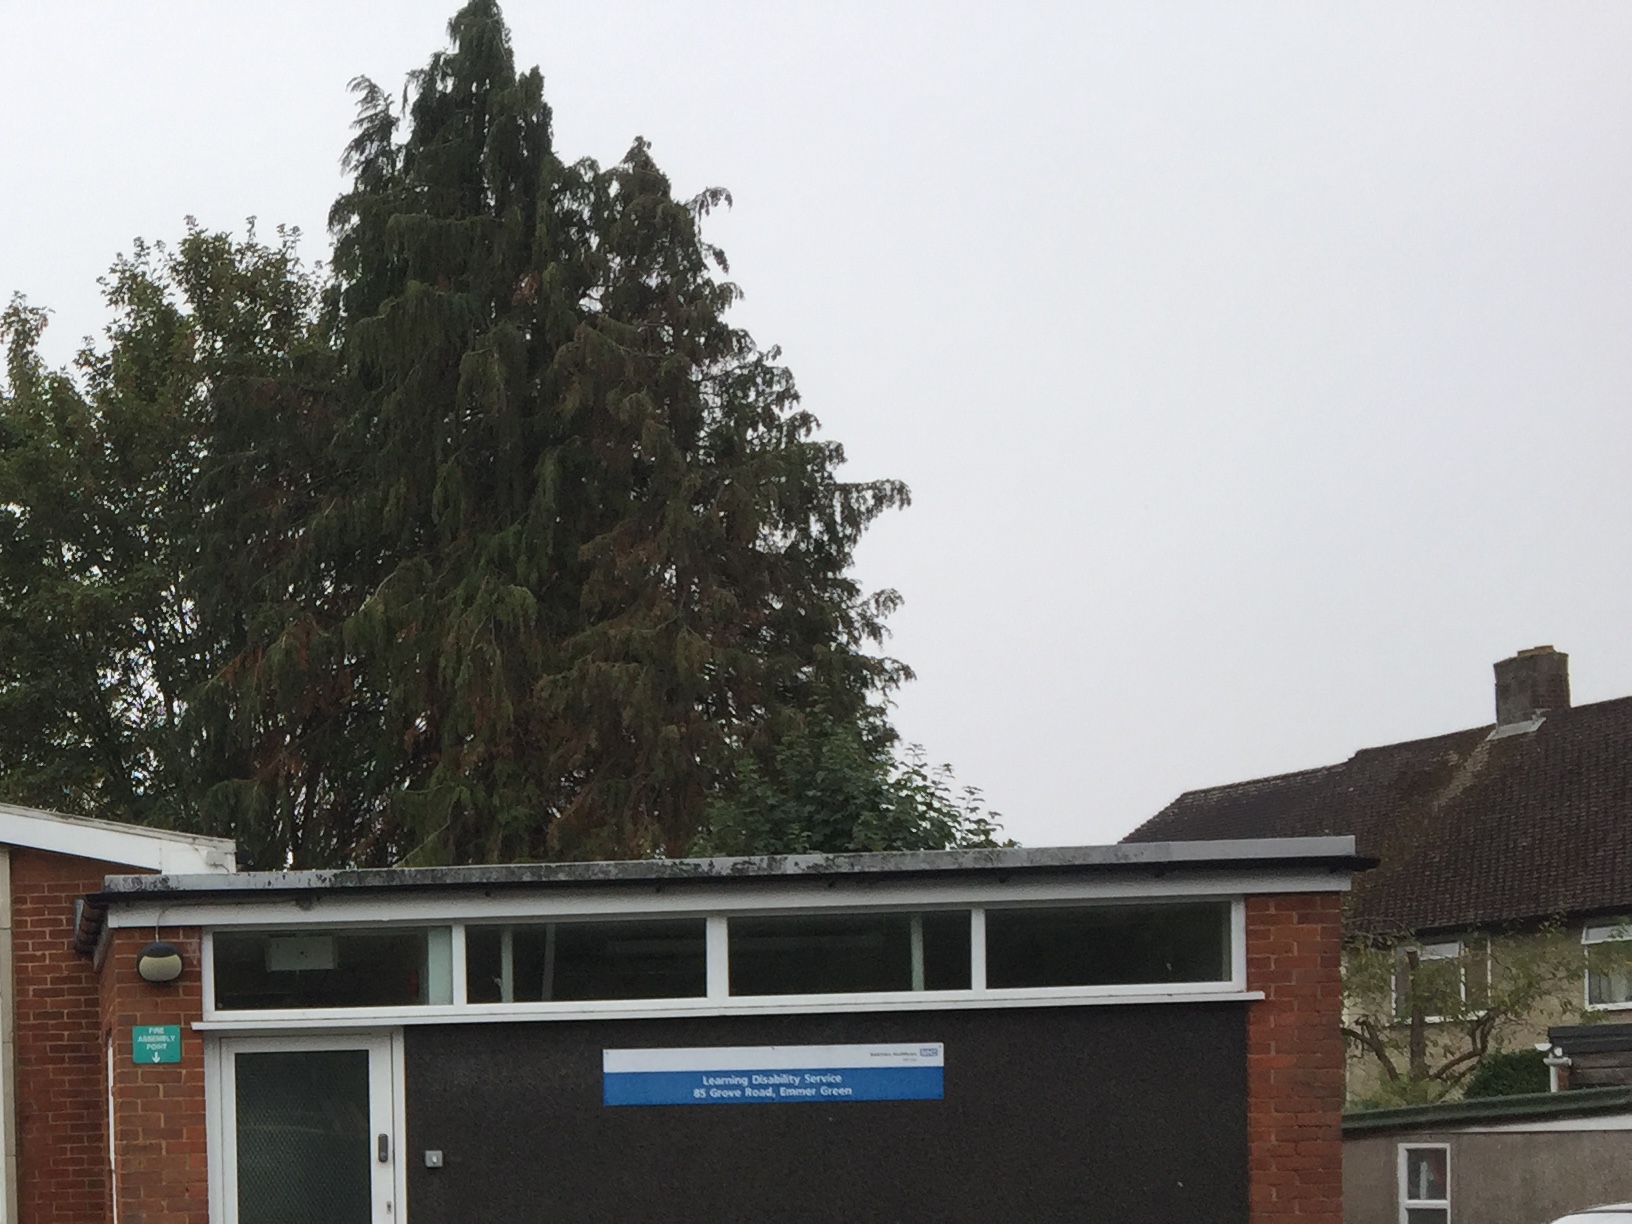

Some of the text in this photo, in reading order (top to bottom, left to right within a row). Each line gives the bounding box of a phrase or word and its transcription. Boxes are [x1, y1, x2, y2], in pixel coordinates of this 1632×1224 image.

[702, 1073, 842, 1086] Learning Disability Service
[693, 1086, 852, 1098] 85 Grove Road, Emmer Green
